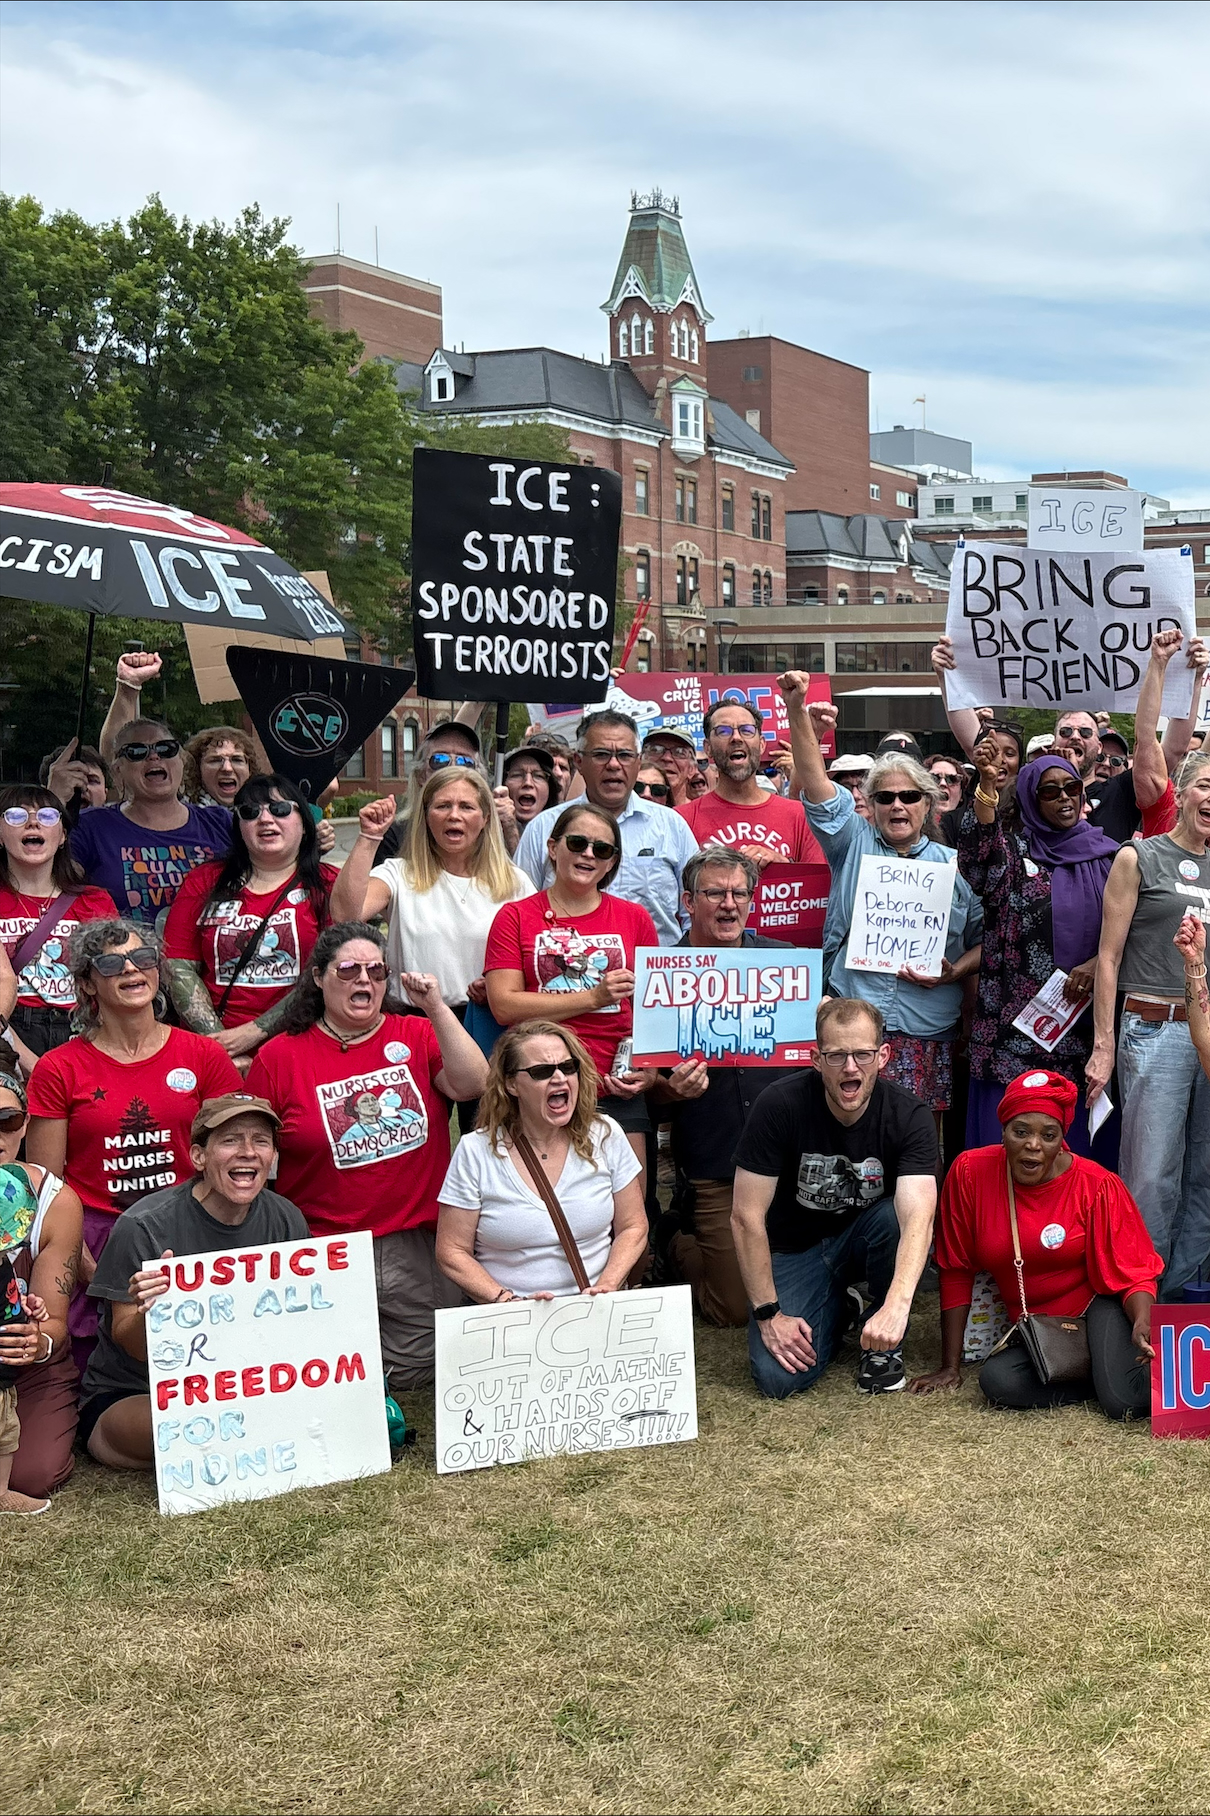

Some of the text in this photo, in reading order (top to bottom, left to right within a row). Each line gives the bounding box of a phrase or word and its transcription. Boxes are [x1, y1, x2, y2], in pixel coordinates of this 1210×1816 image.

[1039, 500, 1127, 538] ICE
[463, 531, 574, 576] STATE
[129, 540, 266, 620] ICE
[963, 551, 1151, 617] BRING
[419, 581, 608, 630] SPONSORED
[423, 632, 611, 682] TERRORISTS
[971, 618, 1080, 658] BACK
[998, 653, 1140, 701] FRIEND
[761, 882, 803, 900] NOT
[761, 897, 829, 914] WELCOME
[865, 891, 934, 914] Debora
[760, 913, 799, 927] HERE!
[866, 912, 945, 932] Kapisha RN
[596, 937, 620, 947] FOR
[646, 954, 717, 970] NURSES SAY
[865, 932, 938, 961] HOME!!
[643, 966, 810, 1008] ABOLISH
[677, 1001, 777, 1060] ICE
[321, 1068, 408, 1101] NURSES FOR
[104, 1128, 172, 1150] MAINE
[335, 1118, 426, 1160] DEMOCRACY
[103, 1150, 175, 1172] NURSES
[107, 1171, 177, 1194] UNITED
[798, 1190, 813, 1200] NOT
[150, 1281, 334, 1333] FOR ALL
[151, 1333, 217, 1371] OR
[458, 1297, 663, 1376] ICE
[157, 1353, 366, 1410] FREEDOM
[444, 1352, 686, 1412] OUT OF MAINE
[463, 1381, 677, 1437] & HANDS OFF
[158, 1408, 246, 1452] FOR
[161, 1440, 298, 1493] NONE
[443, 1434, 516, 1468] OUR
